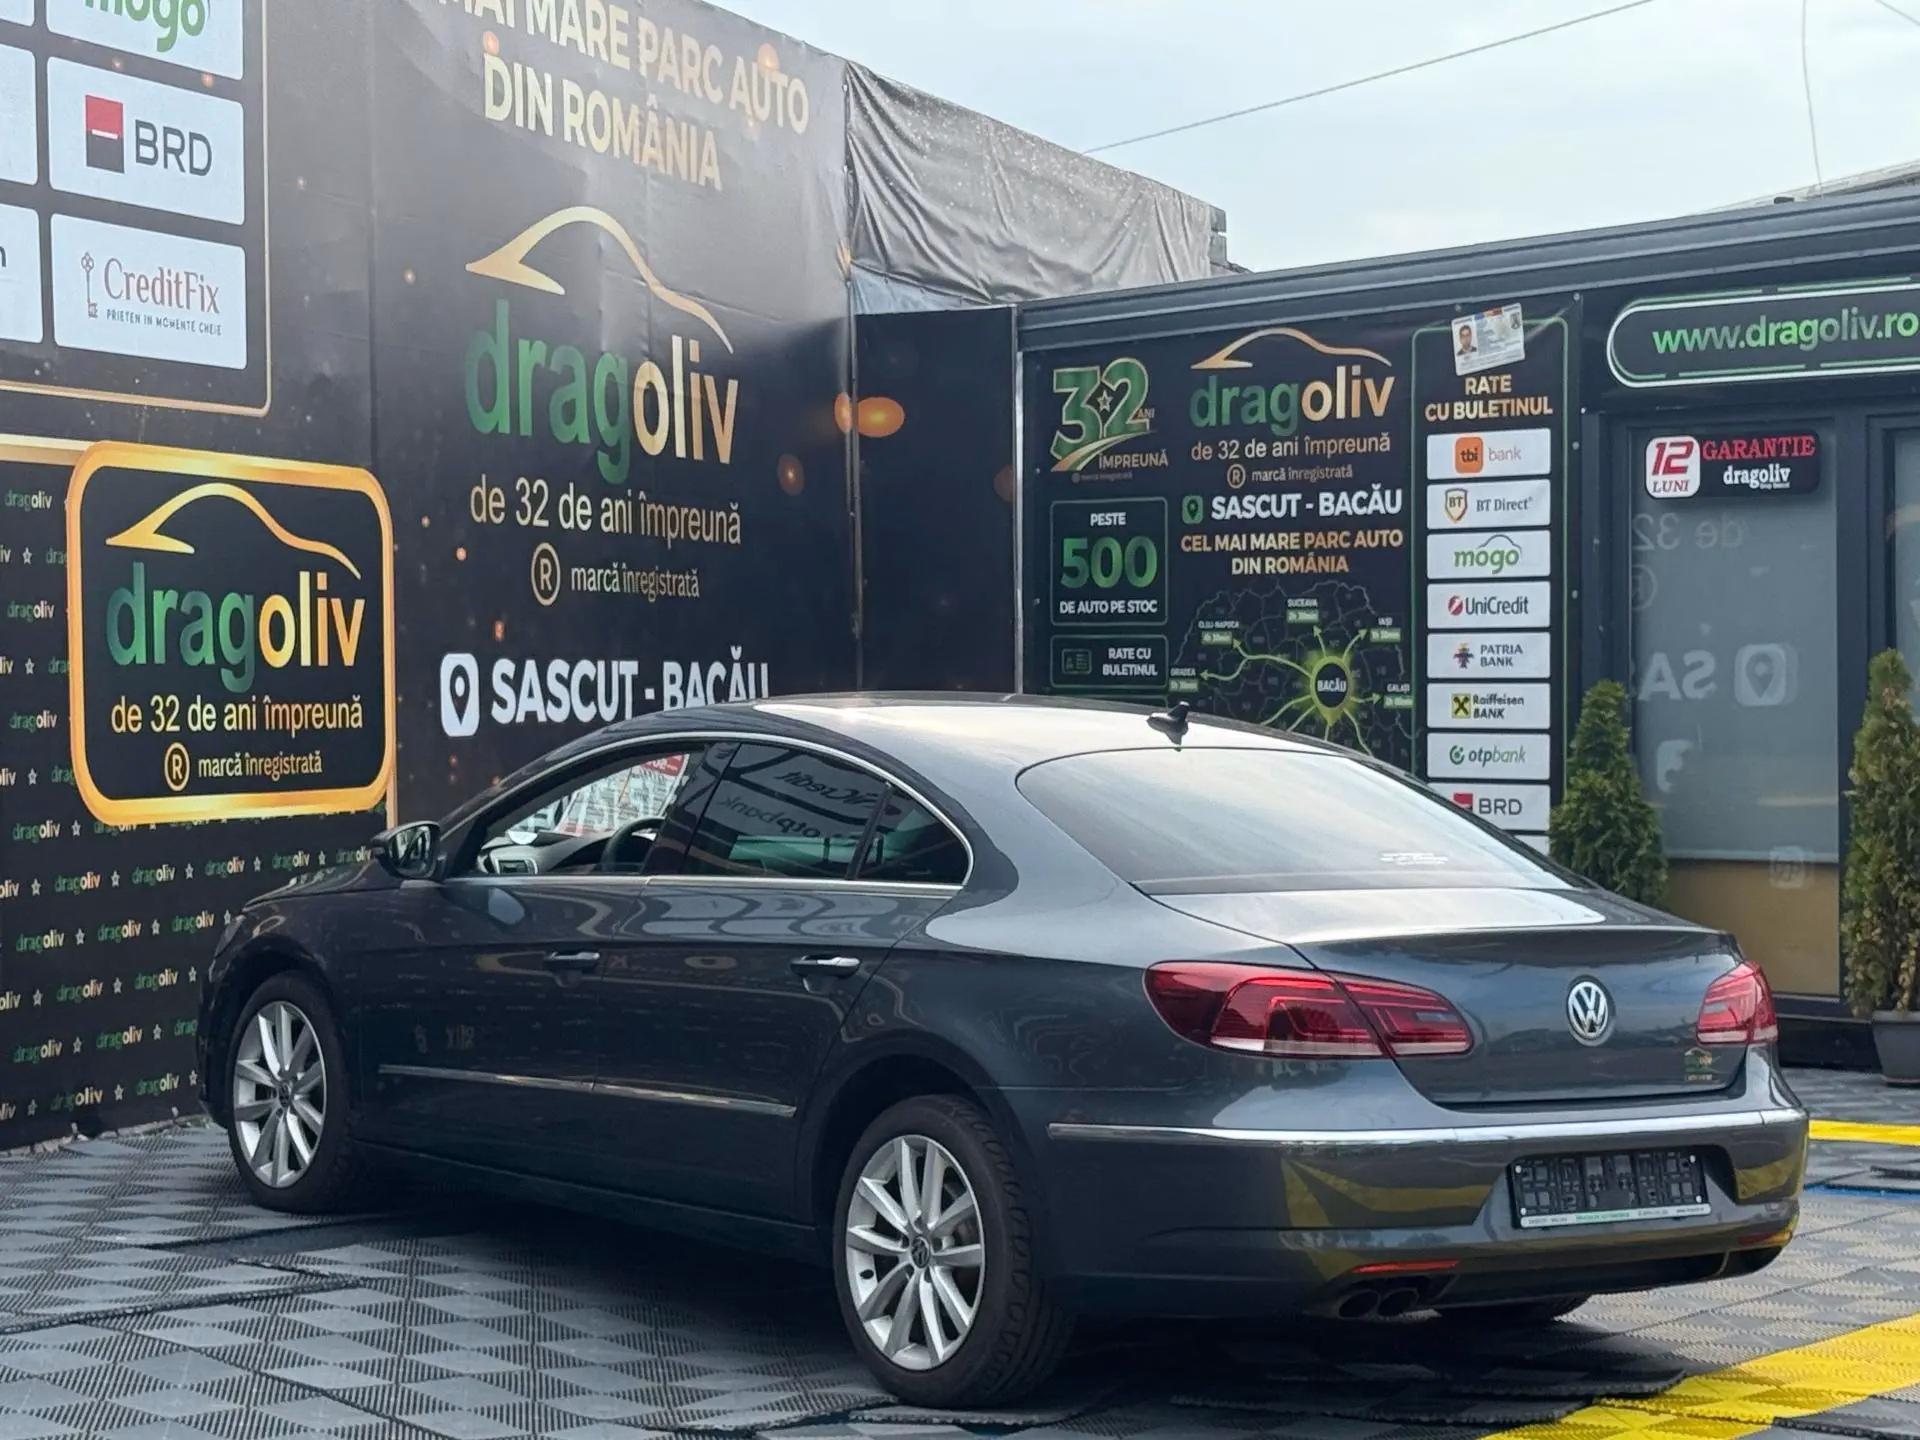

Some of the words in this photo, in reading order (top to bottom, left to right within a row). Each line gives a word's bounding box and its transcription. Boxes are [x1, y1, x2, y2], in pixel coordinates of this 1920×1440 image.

[525, 0, 631, 71] MARE
[638, 16, 724, 104] PARC
[729, 55, 809, 134] AUTO
[483, 53, 554, 137] DIN
[562, 79, 722, 192] ROMÂNIA
[134, 120, 213, 177] BRD
[104, 257, 220, 314] CreditFix
[106, 308, 141, 325] PRIETEN
[143, 314, 153, 325] IN
[156, 317, 196, 333] MOMENTE
[1652, 306, 1919, 354] www.dragoliv.ro
[465, 299, 739, 484] dragoliv
[1464, 373, 1512, 396] RATE
[1050, 358, 1149, 461] 32
[1189, 365, 1395, 437] dragoliv
[1424, 401, 1449, 422] CU
[1453, 396, 1554, 421] BULETINUL
[1191, 442, 1212, 461] de
[1218, 440, 1240, 460] 32
[1244, 439, 1268, 459] de
[1272, 437, 1299, 457] ani
[1304, 432, 1391, 459] împreună
[1460, 446, 1479, 464] tbi
[1488, 446, 1522, 461] bank
[1651, 440, 1694, 476] 12
[1701, 435, 1817, 461] GARANTIE
[1252, 467, 1286, 482] marcă
[1288, 464, 1353, 483] înregistrată
[1652, 479, 1689, 493] LUNI
[1722, 463, 1791, 489] dragoliv
[4, 488, 53, 512] dragoliv
[470, 474, 505, 525] de
[515, 477, 550, 528] 32
[558, 482, 592, 532] de
[600, 489, 633, 535] ani
[638, 491, 742, 550] împreună
[1210, 492, 1302, 521] SASCUT
[1318, 483, 1403, 517] BACĂU
[1476, 499, 1490, 512] BT
[1090, 512, 1127, 526] PESTE
[1181, 534, 1212, 552] CEL
[1215, 534, 1247, 551] MAI
[1250, 532, 1301, 551] MARE
[1304, 530, 1351, 549] PARC
[1354, 529, 1403, 548] AUTO
[1060, 535, 1158, 589] 500
[1231, 557, 1262, 575] DIN
[1265, 552, 1349, 575] ROMÂNIA
[1453, 548, 1520, 575] mogo
[571, 563, 621, 593] marcă
[622, 563, 701, 604] înregistrată
[8, 600, 55, 622] dragoliv
[1059, 601, 1075, 614] DE
[1077, 600, 1109, 614] AUTO
[1110, 600, 1126, 614] PE
[1127, 600, 1158, 613] STOC
[1465, 596, 1529, 616] UniCredit
[106, 561, 365, 693] dragoliv
[1108, 648, 1135, 660] RATE
[1136, 648, 1152, 660] CU
[1480, 644, 1523, 655] PATRIA
[1480, 656, 1514, 667] BANK
[1102, 664, 1158, 676] BULETINUL
[490, 657, 639, 725] SASCUT
[1317, 678, 1347, 692] BACĂU
[1473, 694, 1524, 706] Raiffeisen
[9, 710, 58, 733] dragoliv
[111, 695, 143, 734] de
[150, 694, 181, 733] 32
[187, 695, 217, 732] de
[223, 697, 257, 732] ani
[264, 694, 363, 739] împreună
[1473, 707, 1505, 719] BANK
[198, 753, 243, 778] marcă
[245, 749, 322, 782] înregistrată
[1468, 746, 1526, 768] otpbank
[1478, 798, 1523, 815] BRD
[12, 819, 61, 844] dragoliv
[54, 871, 101, 895] dragoliv
[131, 863, 176, 887] dragoliv
[204, 855, 245, 879] dragoliv
[271, 850, 310, 872] dragoliv
[15, 929, 65, 954] dragoliv
[97, 919, 142, 943] dragoliv
[171, 910, 215, 934] dragoliv
[56, 979, 104, 1004] dragoliv
[134, 968, 179, 992] dragoliv
[96, 1025, 143, 1050] dragoliv
[135, 1072, 180, 1096] dragoliv
